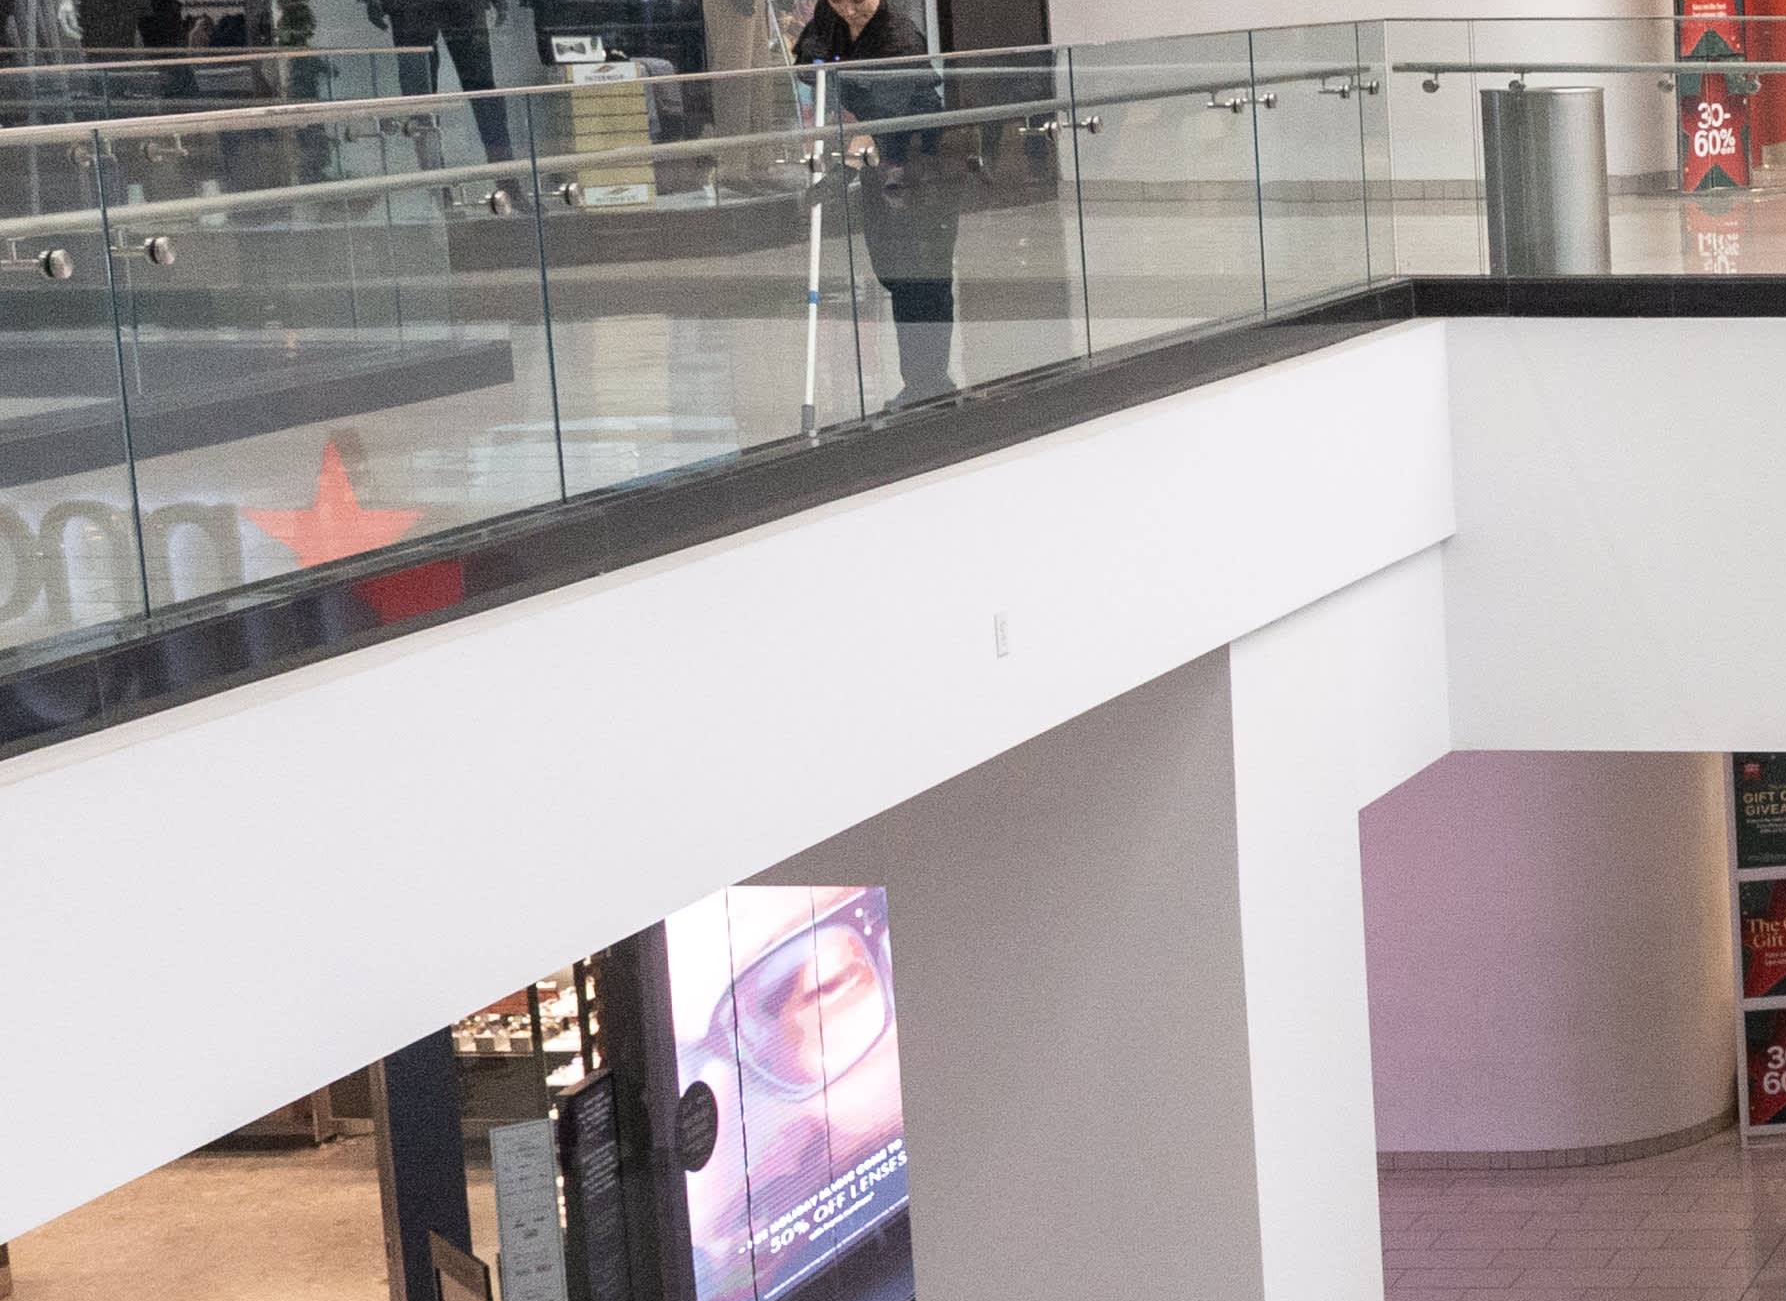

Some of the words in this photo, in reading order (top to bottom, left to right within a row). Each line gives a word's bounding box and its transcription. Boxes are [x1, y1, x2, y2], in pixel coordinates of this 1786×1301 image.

[1697, 102, 1731, 129] 30-
[1693, 128, 1736, 157] 60%
[1743, 791, 1776, 804] GIFT
[1749, 917, 1780, 934] The
[1752, 932, 1783, 948] Gift
[769, 1218, 811, 1254] 50%
[812, 1190, 846, 1223] OFF
[849, 1150, 908, 1199] LENSES
